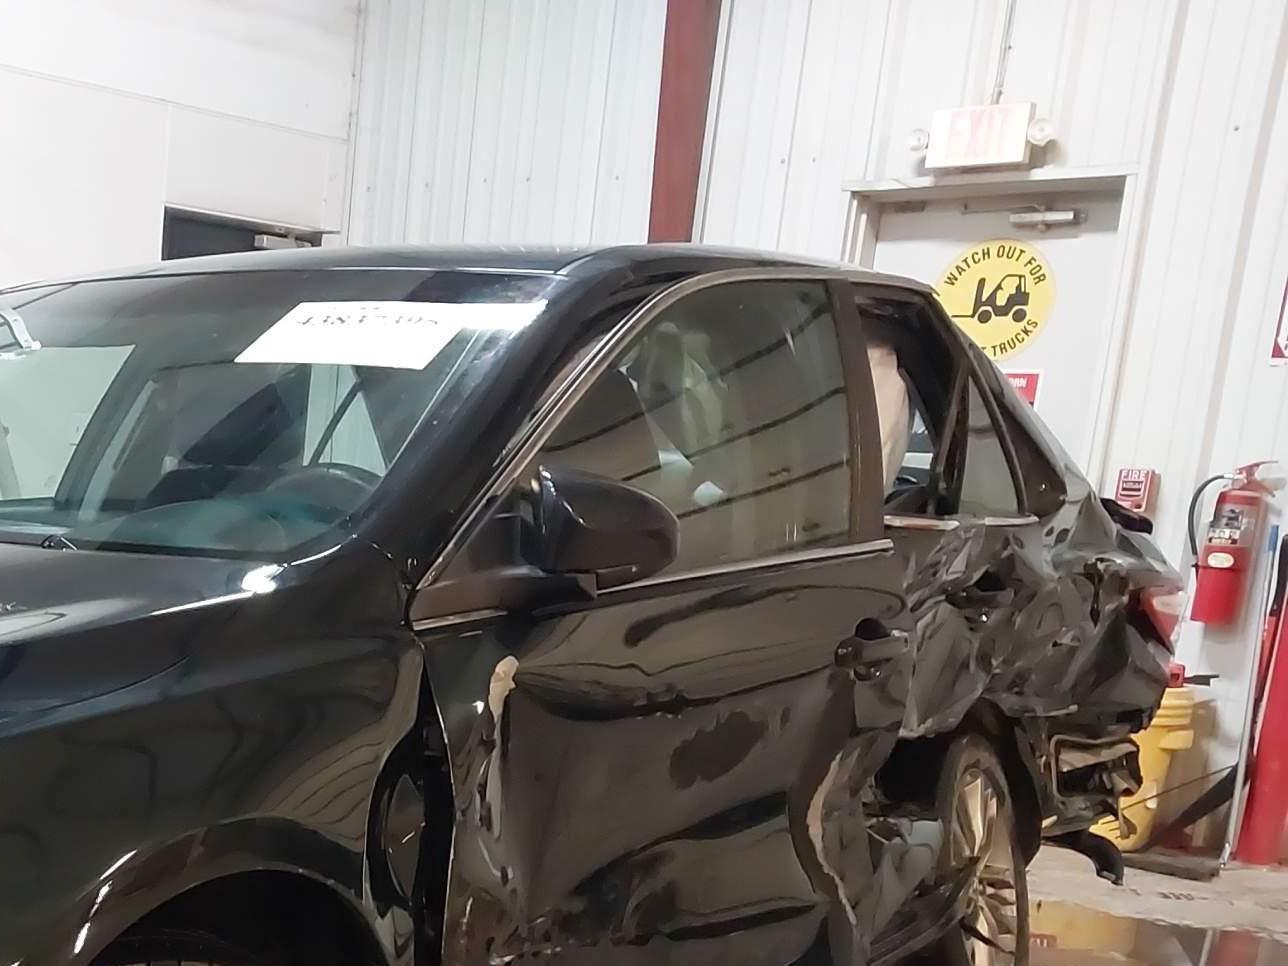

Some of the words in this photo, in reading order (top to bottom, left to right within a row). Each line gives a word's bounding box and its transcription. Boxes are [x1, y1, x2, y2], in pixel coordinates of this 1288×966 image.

[945, 108, 1015, 159] EXIT
[943, 247, 991, 287] WATCH
[996, 244, 1026, 262] OUT
[1024, 255, 1047, 286] FOR
[990, 318, 1039, 357] TRUCKS
[1121, 470, 1146, 480] FIRE
